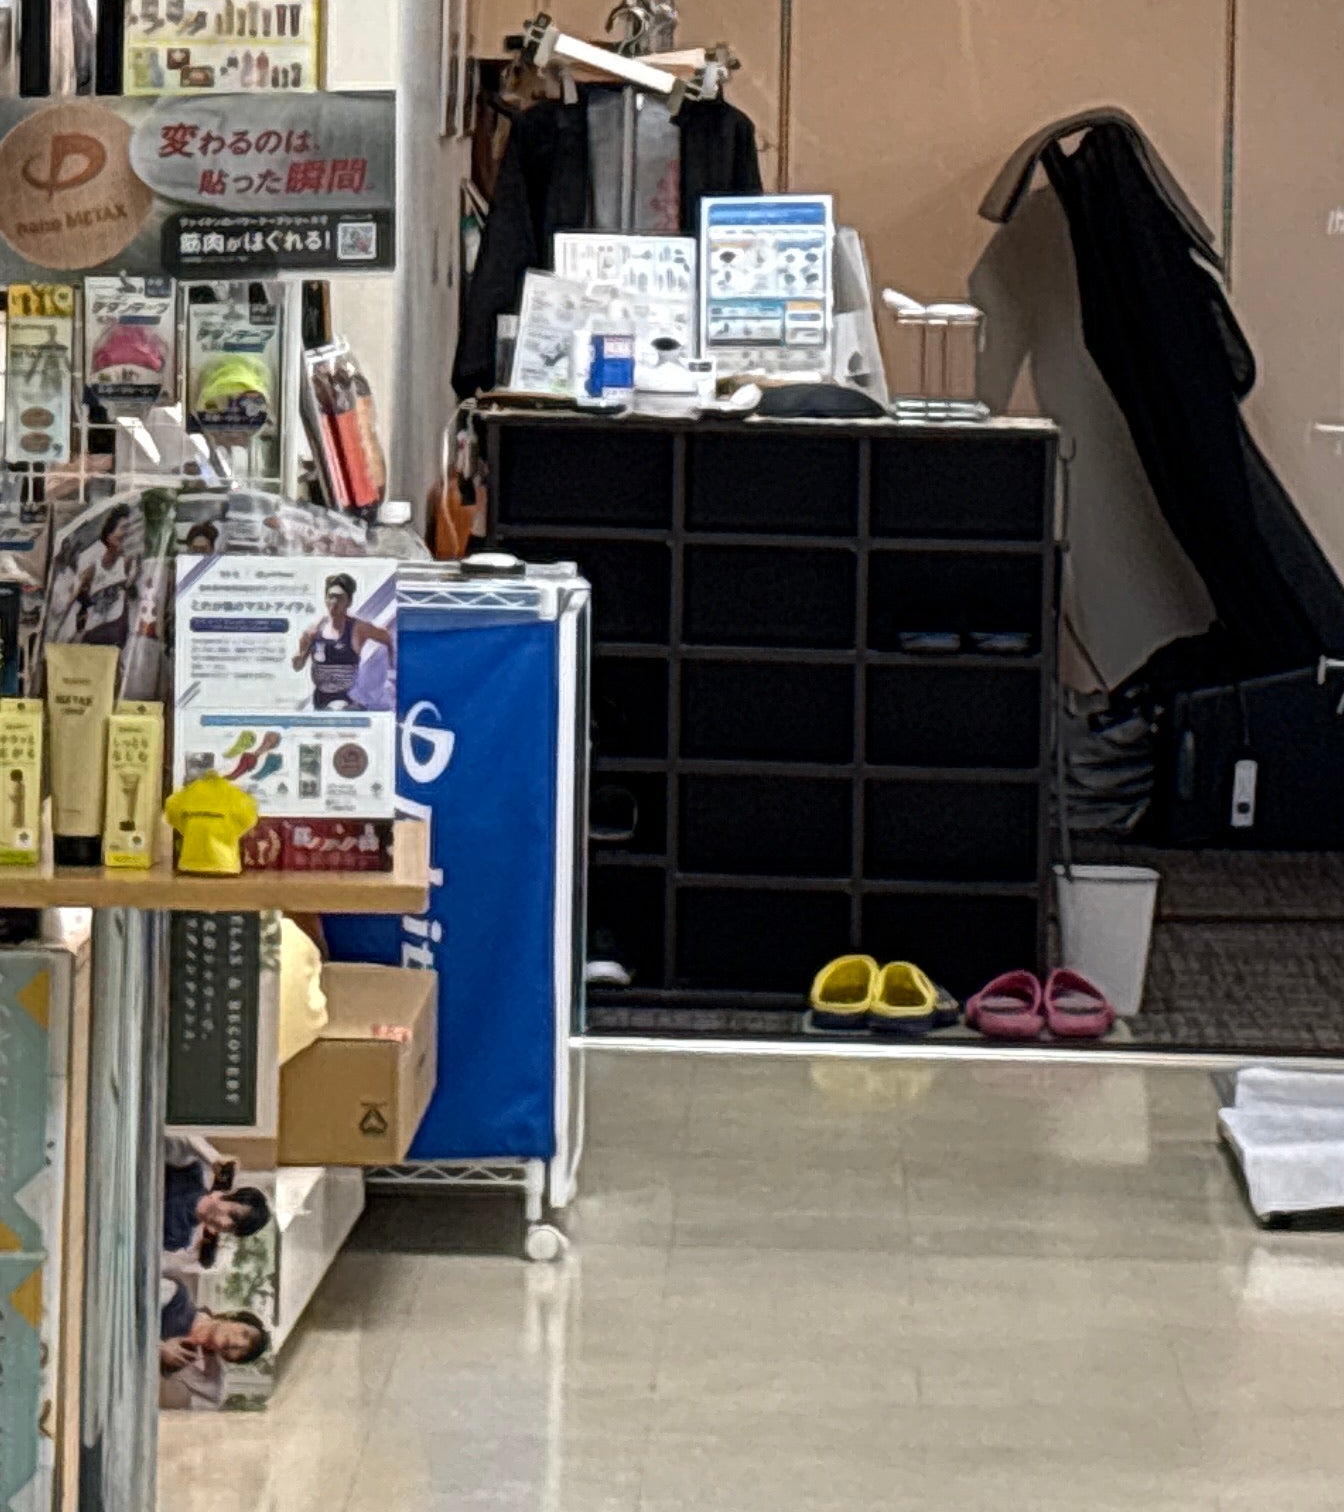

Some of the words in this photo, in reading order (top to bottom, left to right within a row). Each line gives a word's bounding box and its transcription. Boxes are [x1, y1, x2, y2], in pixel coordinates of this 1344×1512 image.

[159, 123, 321, 158] 変わるのは、
